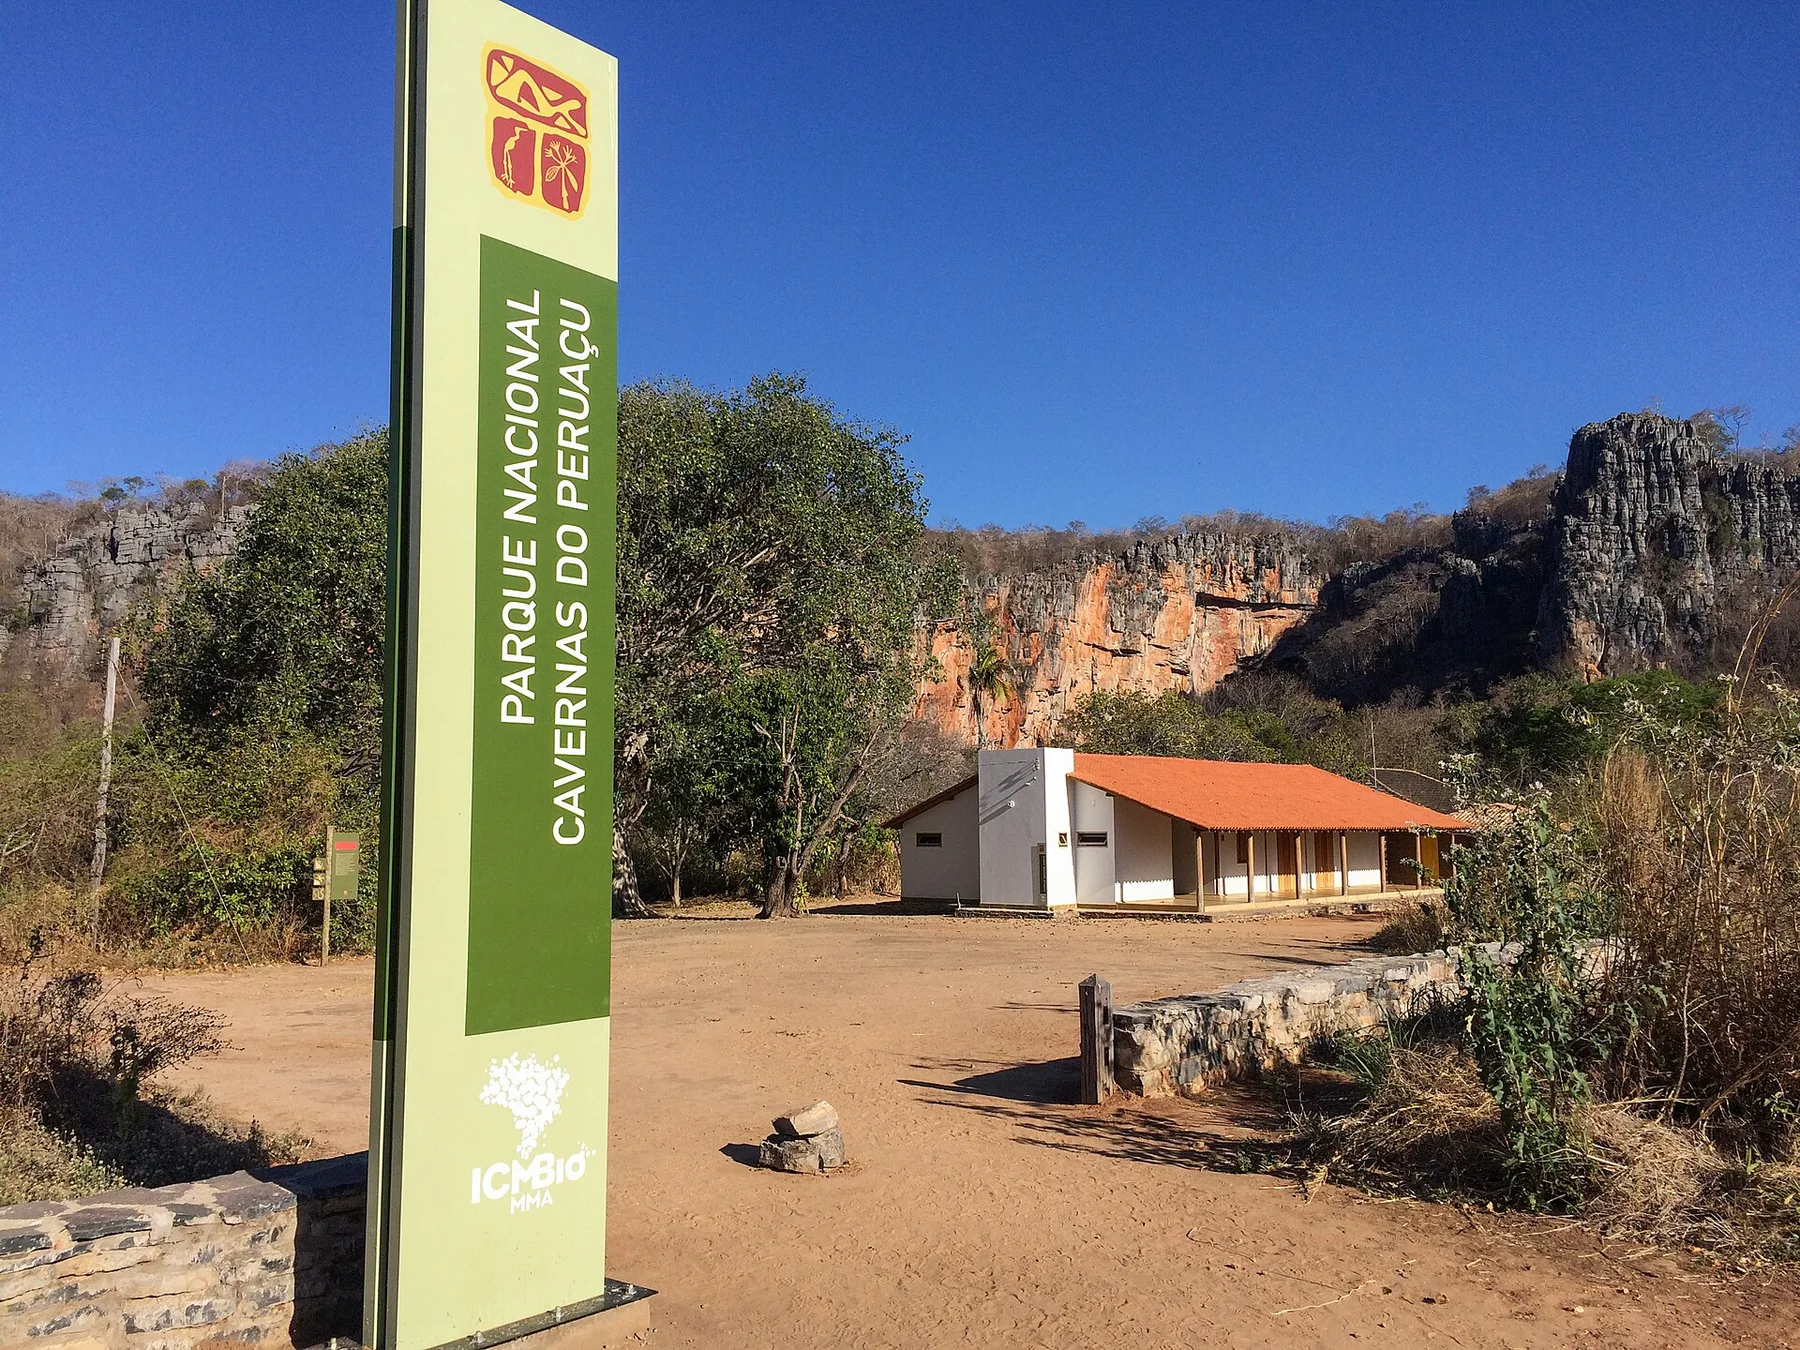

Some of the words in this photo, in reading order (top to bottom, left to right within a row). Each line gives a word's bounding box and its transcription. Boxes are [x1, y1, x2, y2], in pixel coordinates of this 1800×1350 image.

[503, 289, 541, 525] NACIONAL
[556, 298, 600, 512] PERUAÇU
[500, 536, 538, 726] PARQUE
[555, 525, 589, 588] DO
[552, 601, 588, 846] CAVERNAS
[510, 1187, 554, 1215] MMA
